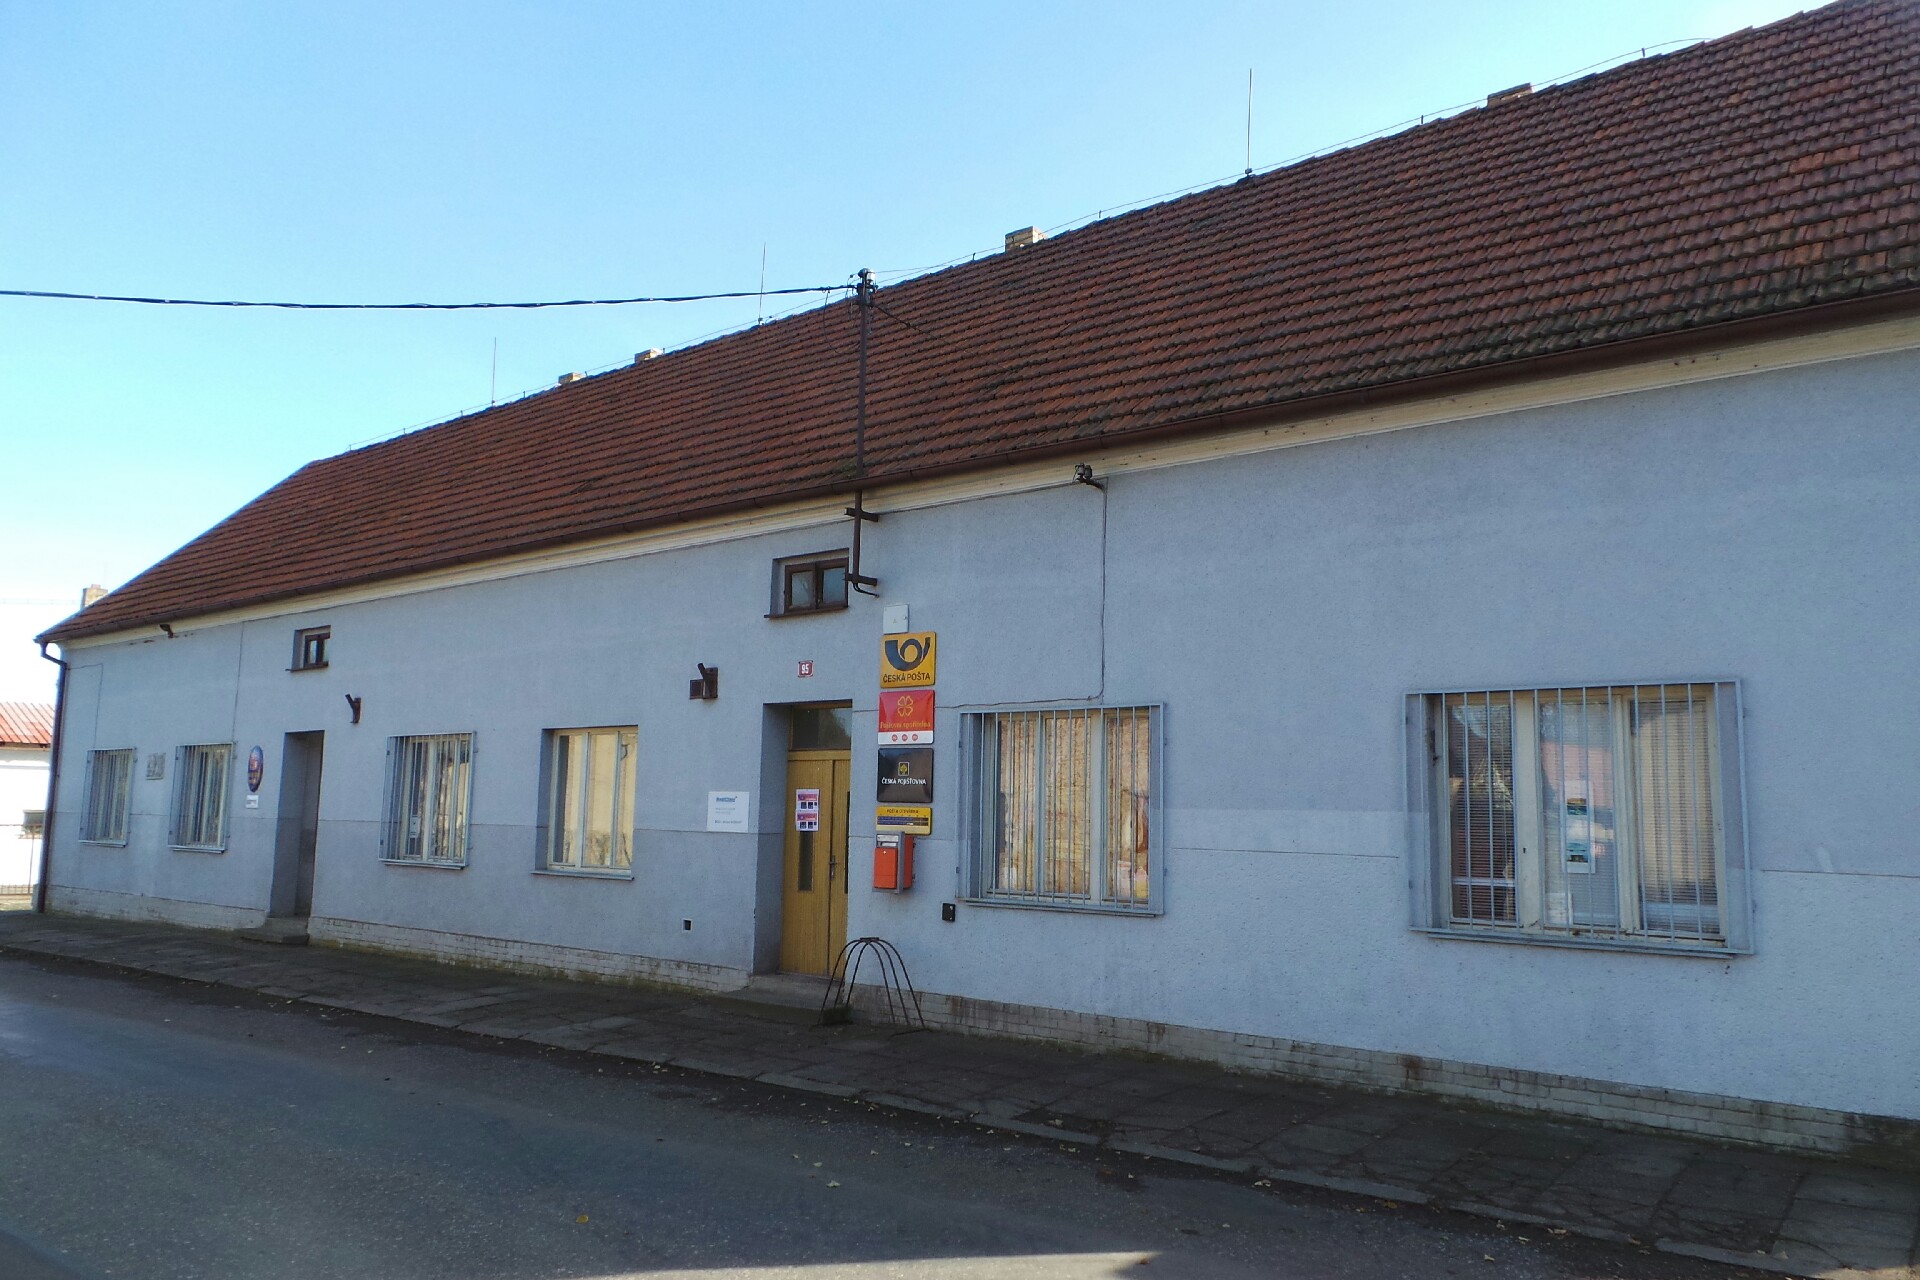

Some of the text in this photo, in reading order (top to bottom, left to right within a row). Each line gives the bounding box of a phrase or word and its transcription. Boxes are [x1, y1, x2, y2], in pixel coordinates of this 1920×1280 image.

[801, 664, 809, 674] 95
[882, 671, 930, 683] ČESKÁ POŠTA
[881, 777, 927, 785] ČESKÁ POJIŠŤOVNA
